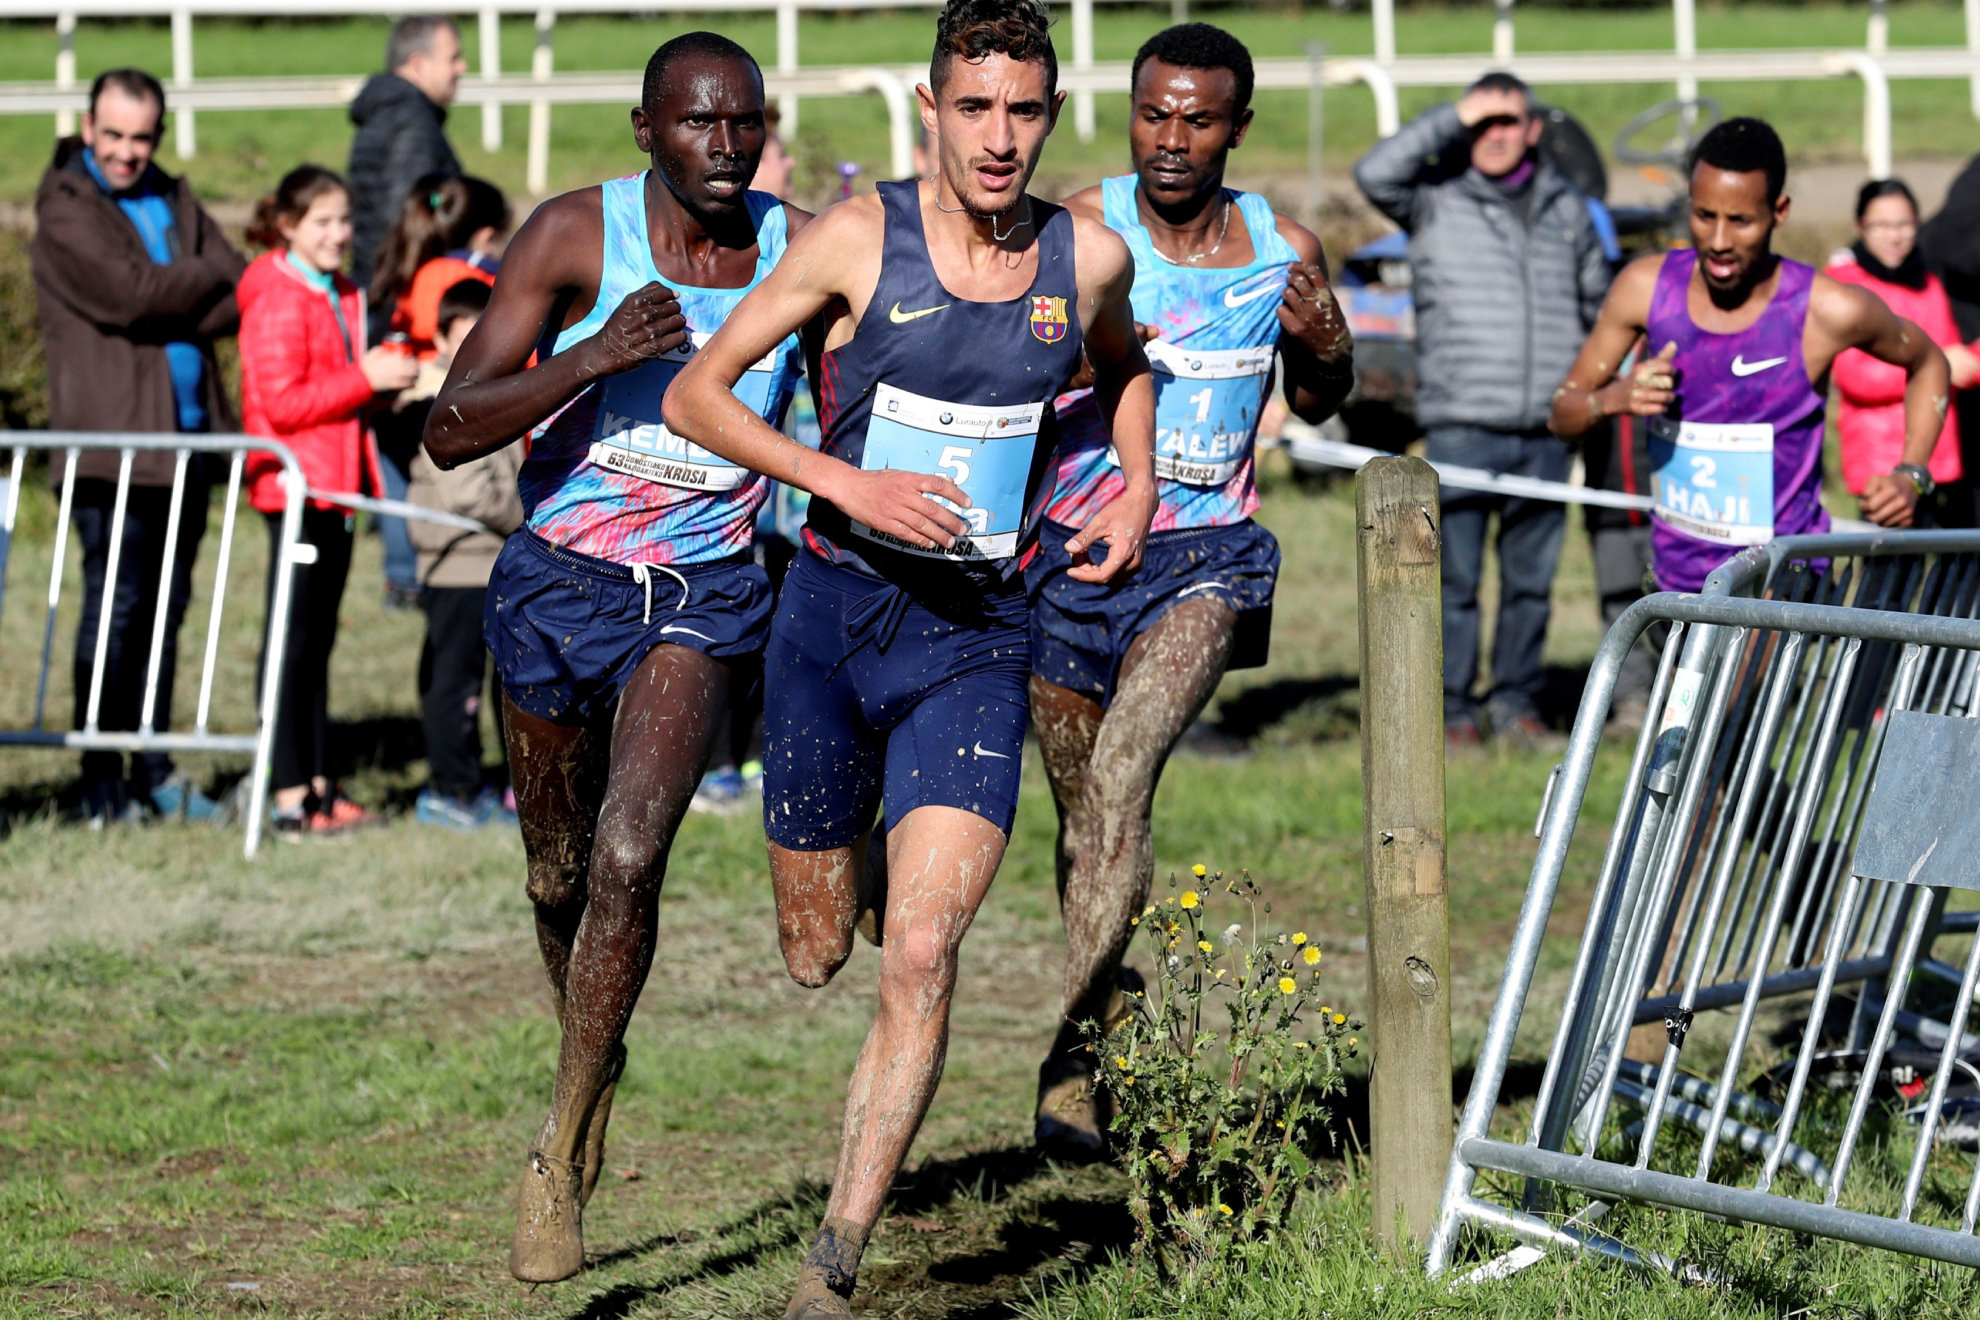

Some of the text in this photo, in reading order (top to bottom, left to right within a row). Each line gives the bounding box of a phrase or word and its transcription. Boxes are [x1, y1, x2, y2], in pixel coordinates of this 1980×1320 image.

[955, 416, 987, 427] Lurauto
[1190, 387, 1213, 423] 1
[601, 411, 713, 459] KEM
[606, 451, 626, 468] 63
[663, 464, 708, 486] KROSA
[937, 445, 973, 486] 5
[1690, 454, 1717, 488] 2
[1667, 480, 1750, 525] HAJI
